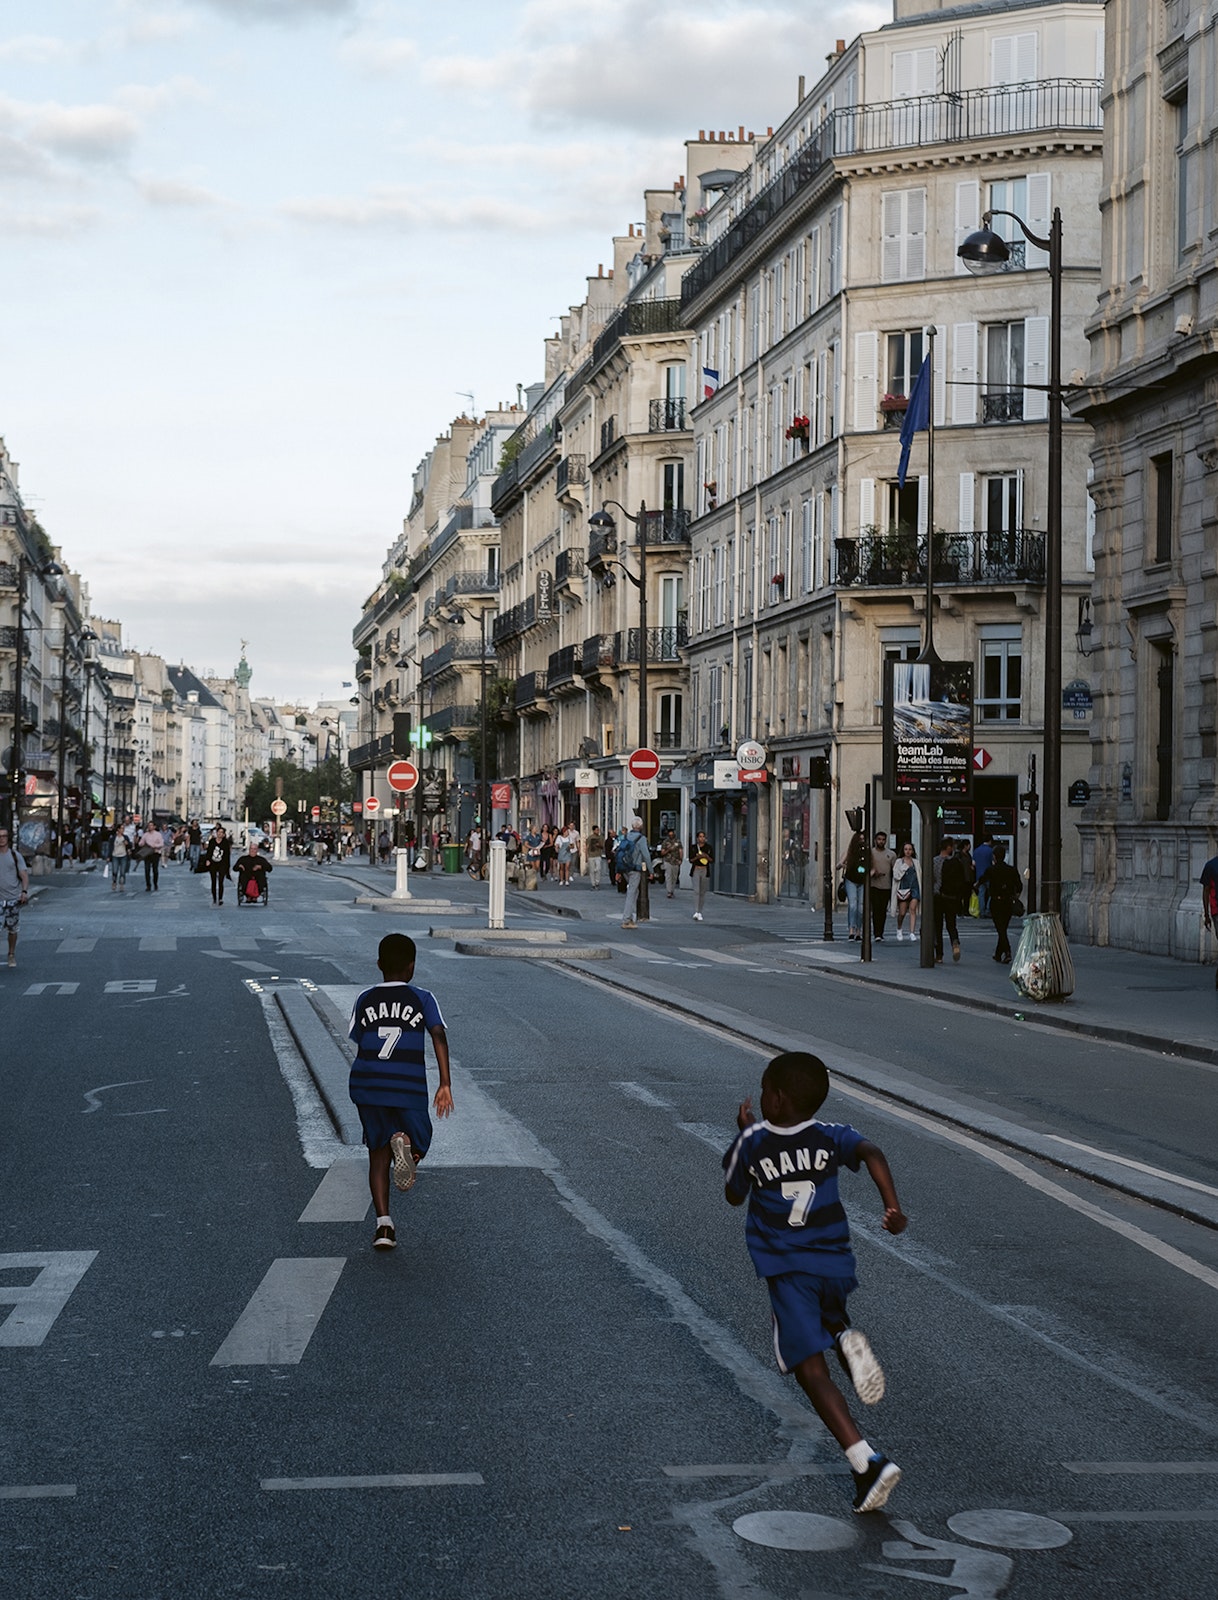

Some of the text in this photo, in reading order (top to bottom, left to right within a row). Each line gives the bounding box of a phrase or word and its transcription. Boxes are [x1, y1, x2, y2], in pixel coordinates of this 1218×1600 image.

[1074, 710, 1085, 718] 30
[897, 744, 943, 756] teamLab
[740, 756, 763, 764] HSBC
[897, 755, 967, 765] Au-delà des limites
[377, 1026, 402, 1060] 7
[749, 1148, 834, 1188] RANC
[781, 1180, 816, 1227] 7
